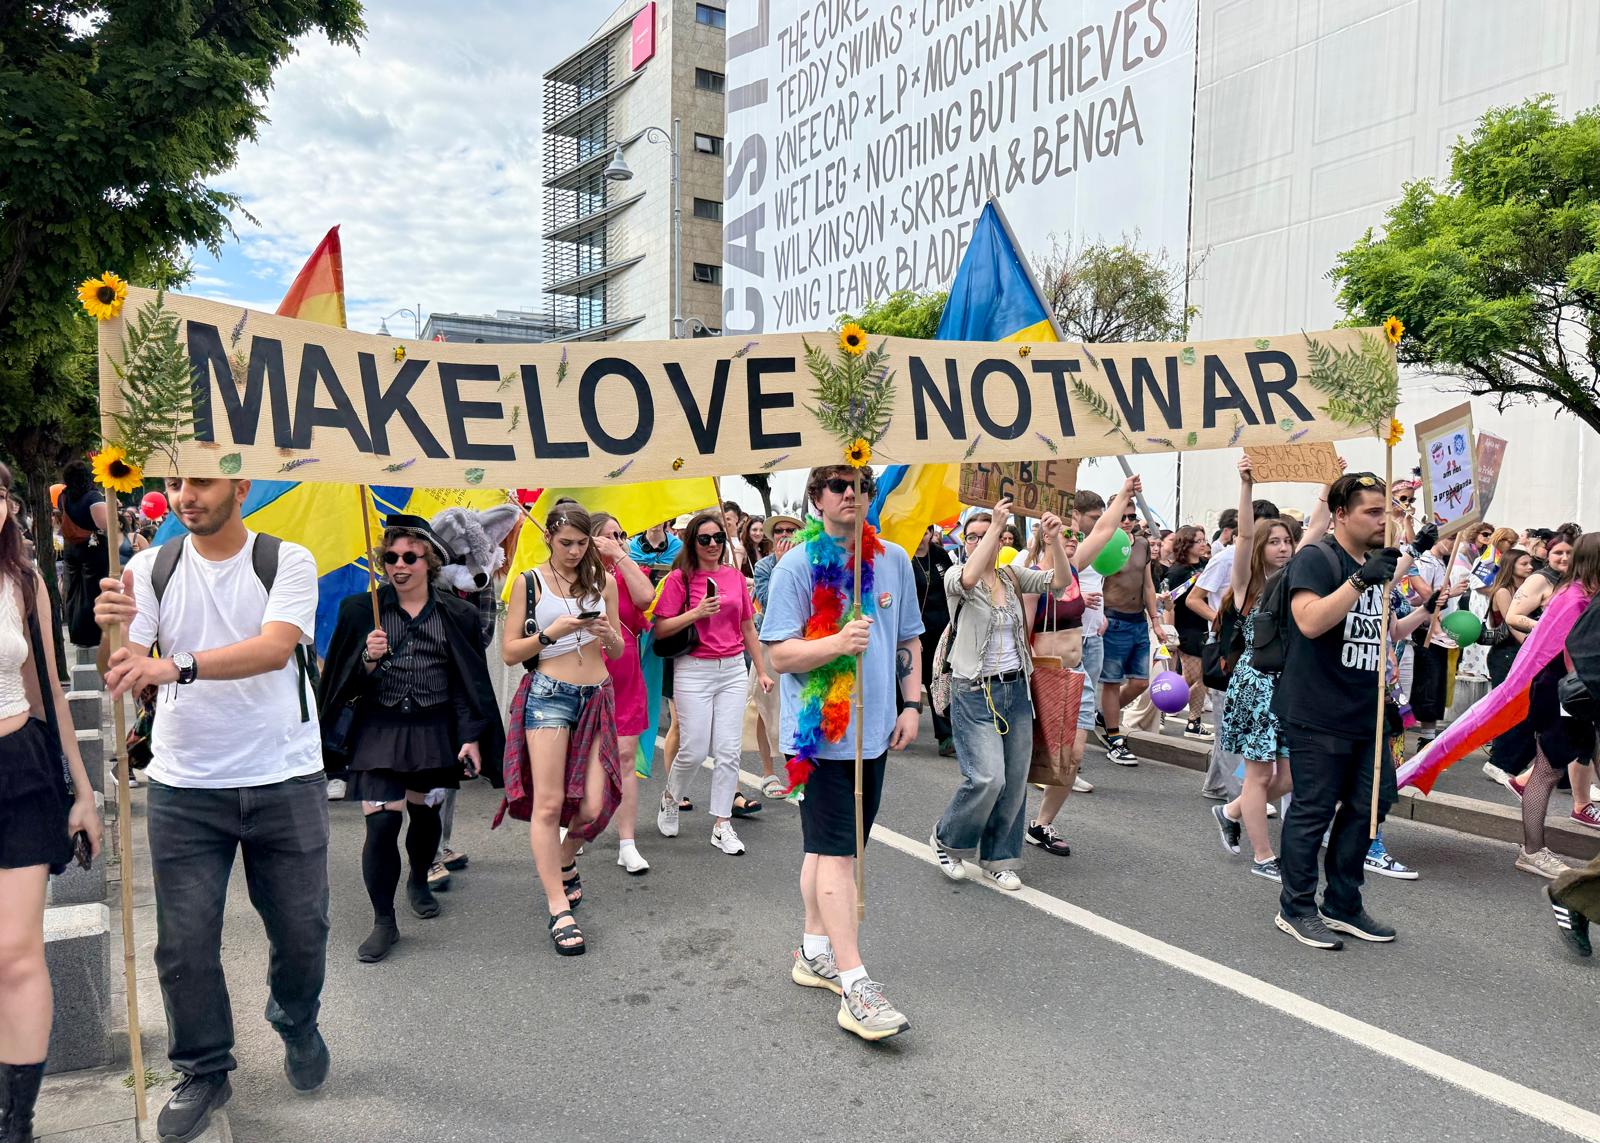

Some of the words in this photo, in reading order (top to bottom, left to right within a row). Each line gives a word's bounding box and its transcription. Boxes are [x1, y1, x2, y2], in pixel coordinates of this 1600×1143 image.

[777, 51, 832, 124] TEDDY
[836, 5, 903, 88] SWIMS
[778, 10, 810, 72] THE
[879, 64, 907, 124] LP
[923, 0, 1048, 98] MOCHAKK
[775, 174, 811, 231] WET
[815, 156, 847, 216] LEG
[867, 101, 962, 193] NOTHING
[970, 61, 1023, 142] BUT
[1027, 0, 1167, 112] THIEVES
[774, 194, 884, 283] WILKINSON
[901, 145, 1000, 234] SKREAM
[1005, 138, 1025, 194] &
[1031, 85, 1143, 185] BENGA
[773, 278, 820, 331] YUNG
[828, 261, 871, 315] LEAN
[874, 255, 890, 300] &
[896, 218, 980, 293] BLADE
[187, 319, 516, 461] MAKE
[520, 357, 802, 458] LOVE
[908, 355, 1081, 441] NOT
[1101, 350, 1315, 432] WAR
[1442, 469, 1452, 479] am
[1452, 464, 1462, 476] not
